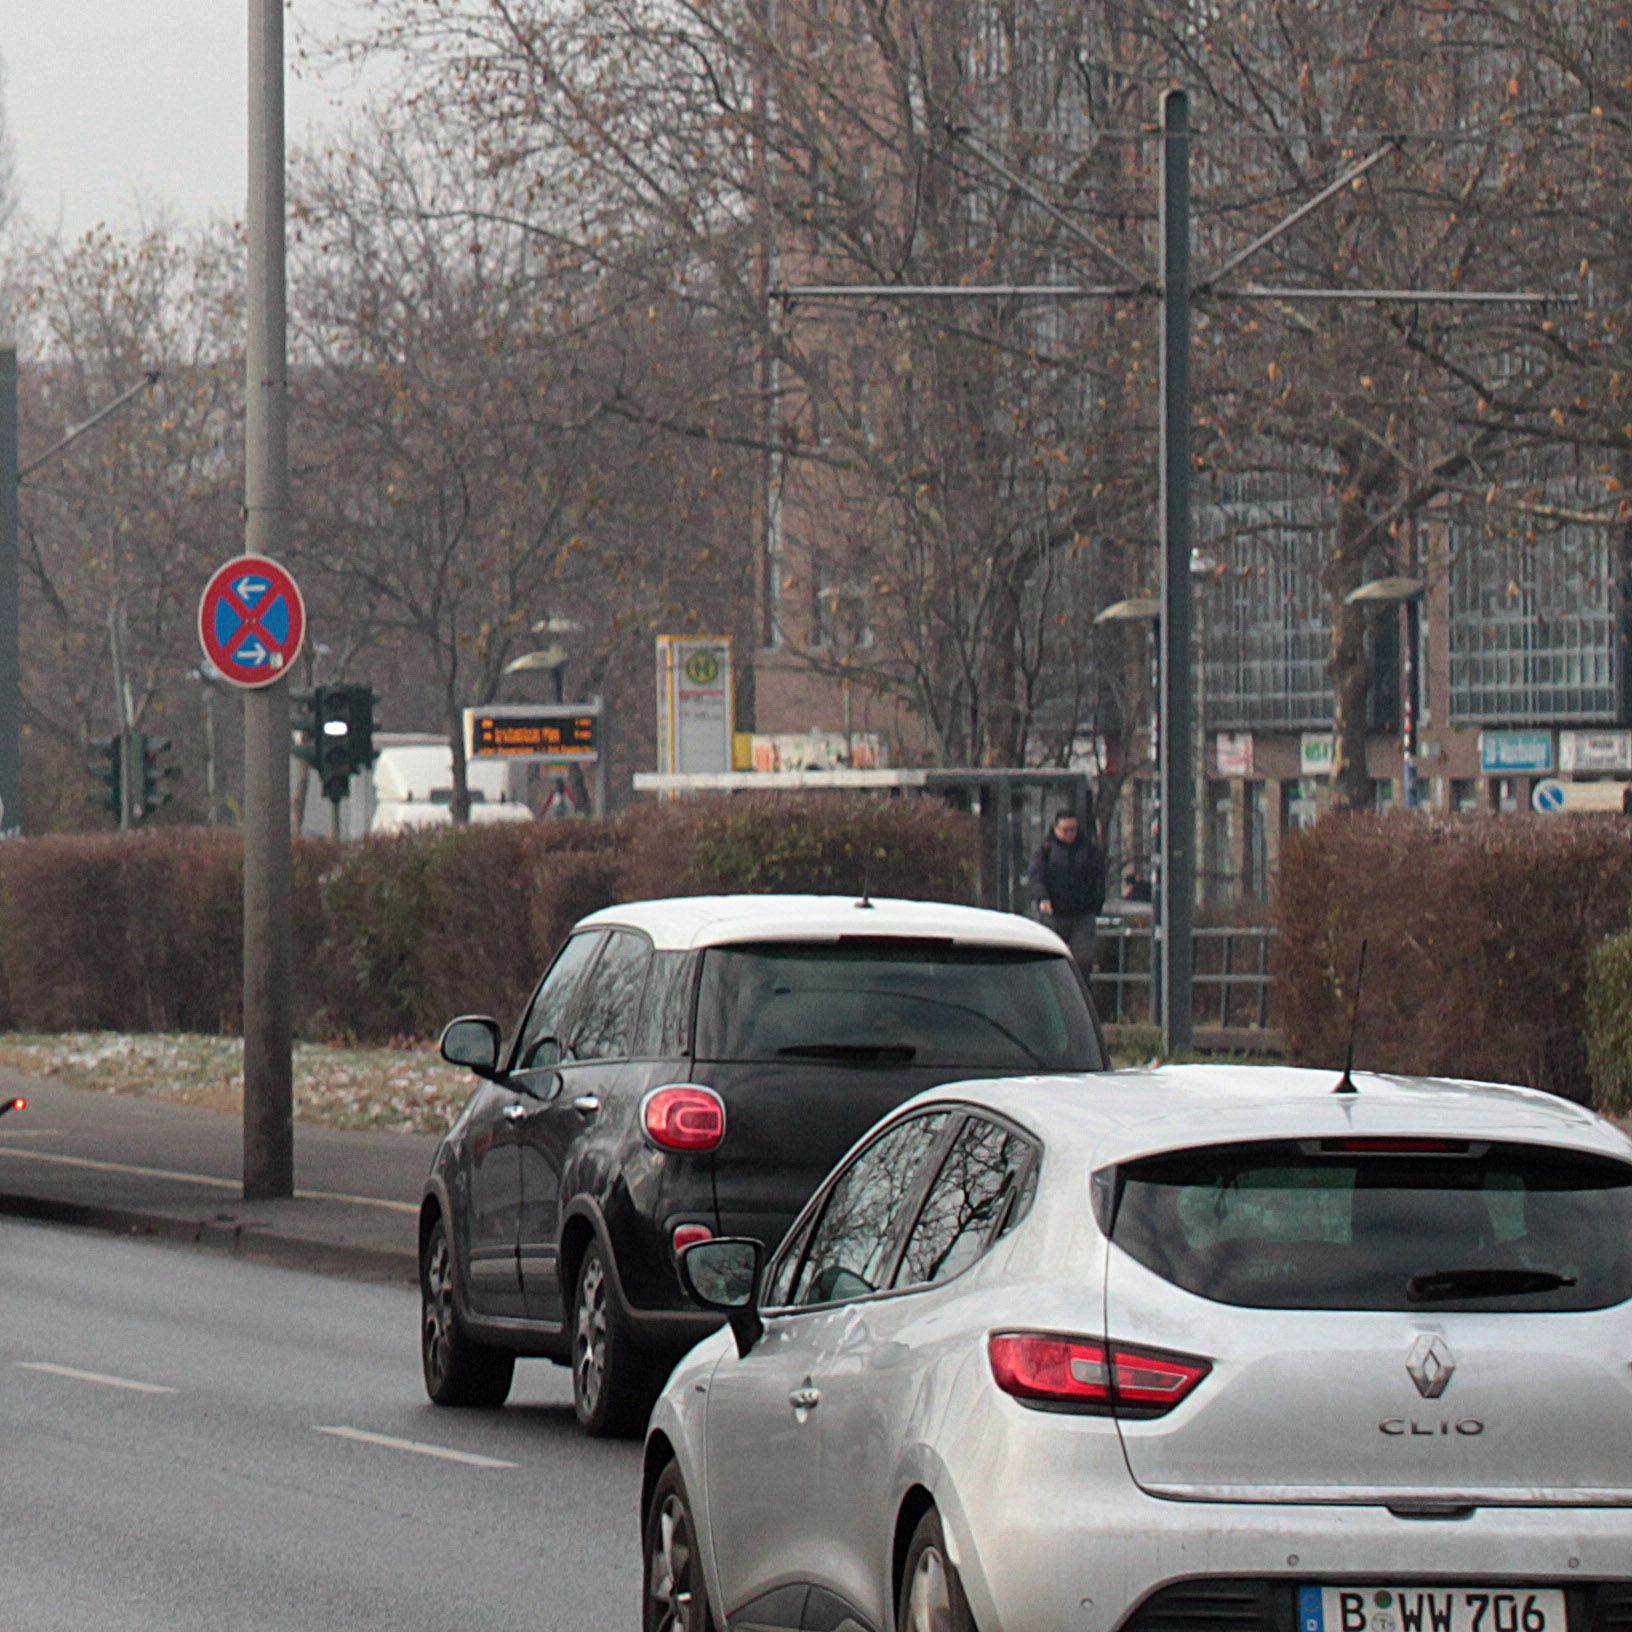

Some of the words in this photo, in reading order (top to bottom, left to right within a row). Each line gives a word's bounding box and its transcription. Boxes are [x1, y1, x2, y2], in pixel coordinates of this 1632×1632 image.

[1379, 1419, 1484, 1435] CLIO
[1339, 1592, 1366, 1632] B
[1398, 1592, 1453, 1632] WW
[1465, 1594, 1545, 1632] 706
